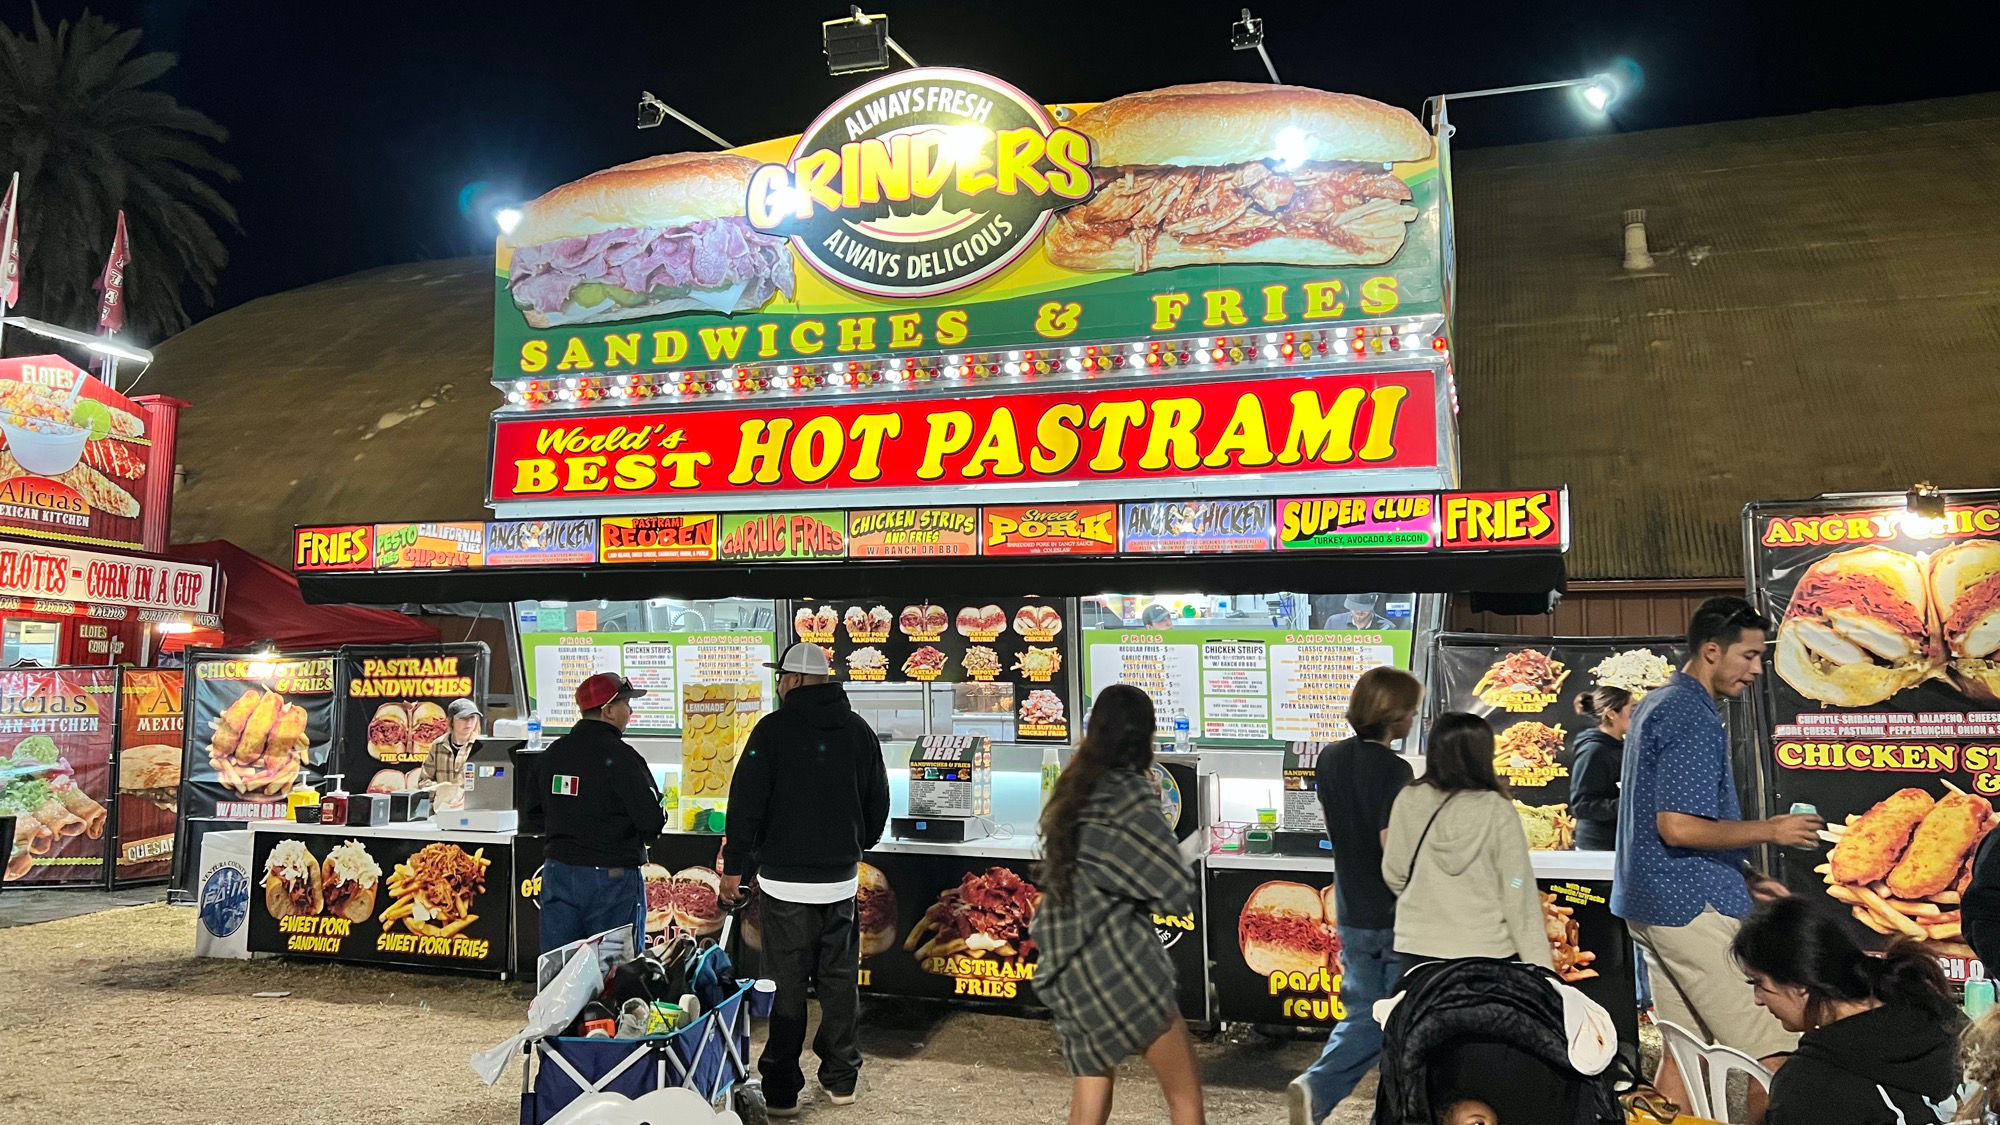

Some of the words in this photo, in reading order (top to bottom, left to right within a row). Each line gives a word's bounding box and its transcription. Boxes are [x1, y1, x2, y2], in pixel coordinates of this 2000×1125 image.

[844, 86, 926, 141] ALWAYS
[927, 86, 994, 124] FRESH
[747, 126, 1094, 229] GRINDERS
[822, 228, 900, 277] ALWAYS
[907, 213, 1013, 280] DELICIOUS
[520, 311, 968, 372] SANDWICHES
[1035, 302, 1082, 337] &
[1151, 276, 1400, 330] FRIES
[22, 365, 73, 388] ELOTES
[512, 451, 712, 494] BEST
[728, 412, 902, 486] HOT
[916, 385, 1408, 481] PASTRAMI
[536, 424, 688, 455] World's
[0, 481, 82, 512] Alicias
[0, 503, 38, 521] EXICAN
[42, 510, 89, 528] KITCHEN
[633, 517, 683, 529] PASTRAMI
[851, 510, 916, 537] CHICKEN
[920, 508, 975, 535] STRIPS
[1020, 509, 1077, 521] Sweet
[1128, 503, 1181, 537] ANGR
[1193, 501, 1267, 536] HICKEN
[1280, 498, 1365, 543] SUPER
[1373, 496, 1432, 520] CLUB
[1446, 493, 1552, 541] FRIES
[418, 523, 482, 545] CALIFORNIA
[489, 522, 532, 551] ANGR
[602, 519, 715, 548] REUBEN
[723, 514, 786, 557] GARLIC
[790, 516, 844, 556] FRIES
[883, 530, 907, 544] AND
[908, 529, 940, 543] FRIES
[988, 510, 1113, 547] PORK
[1766, 515, 1897, 543] ANGRY
[297, 528, 368, 566] FRIES
[376, 524, 417, 555] PESTO
[457, 541, 481, 553] FRIES
[867, 547, 880, 555] W/
[884, 546, 917, 555] RANCH
[921, 546, 934, 554] OR
[939, 545, 959, 554] BBQ
[1313, 535, 1345, 546] TURKEY,
[1347, 534, 1383, 545] AVOCADO
[1385, 534, 1393, 543] &
[1395, 533, 1424, 543] BACON
[0, 551, 67, 593] ELOTES
[87, 561, 129, 600] CORN
[133, 565, 154, 602] IN
[155, 573, 169, 605] A
[173, 571, 202, 607] CUP
[79, 624, 108, 639] ELOTES
[1121, 634, 1163, 643] FRIES
[1285, 634, 1382, 644] SANDWICHES
[88, 639, 108, 653] CORN
[625, 646, 650, 655] CHICKEN
[651, 646, 671, 655] STRIPS
[1205, 645, 1236, 655] CHICKEN
[1237, 645, 1263, 655] STRIPS
[198, 660, 274, 679] CHICK
[276, 659, 333, 678] STRIPS
[363, 658, 458, 677] PASTRAMI
[277, 679, 289, 692] &
[291, 678, 333, 692] FRIES
[350, 677, 473, 697] SANDWICHES
[685, 702, 725, 713] LEMONADE
[1493, 693, 1557, 704] PASTRAMI
[1506, 703, 1545, 712] FRIES
[30, 717, 99, 732] KITCHEN
[136, 717, 184, 732] MEXIC
[1797, 714, 1888, 725] CHIPOTLE-SRIRACHA
[1889, 714, 1916, 725] MAYO,
[1919, 714, 1966, 724] JALAPENO,
[1968, 713, 2000, 723] CHEES
[1803, 726, 1837, 736] CHEESE,
[1839, 726, 1885, 736] PASTRAMI,
[1889, 726, 1956, 736] PEPPERONCINI,
[1957, 726, 1987, 735] ONION
[1988, 726, 1996, 735] &
[921, 735, 974, 749] ORDER
[380, 753, 395, 762] THE
[397, 753, 429, 762] CLASSI
[923, 748, 963, 761] HERE
[1778, 743, 1956, 771] CHICKEN
[1496, 767, 1531, 777] WEET
[1533, 767, 1568, 778] PORK
[1509, 777, 1548, 786] FRIES
[216, 802, 228, 817] W/
[230, 803, 258, 818] RANCH
[261, 803, 272, 818] OR
[276, 804, 287, 818] BB
[128, 837, 174, 862] QUESA
[203, 877, 250, 909] FAIR
[279, 914, 319, 936] SWEET
[319, 918, 350, 937] PORK
[287, 936, 340, 953] SANDWICH
[376, 933, 418, 954] SWEET
[418, 936, 451, 956] PORK
[453, 938, 489, 960] FRIES
[932, 956, 1036, 980] PASTRAM
[955, 978, 1017, 999] FRIES
[1270, 967, 1342, 995] pastr
[1284, 995, 1348, 1020] reub
